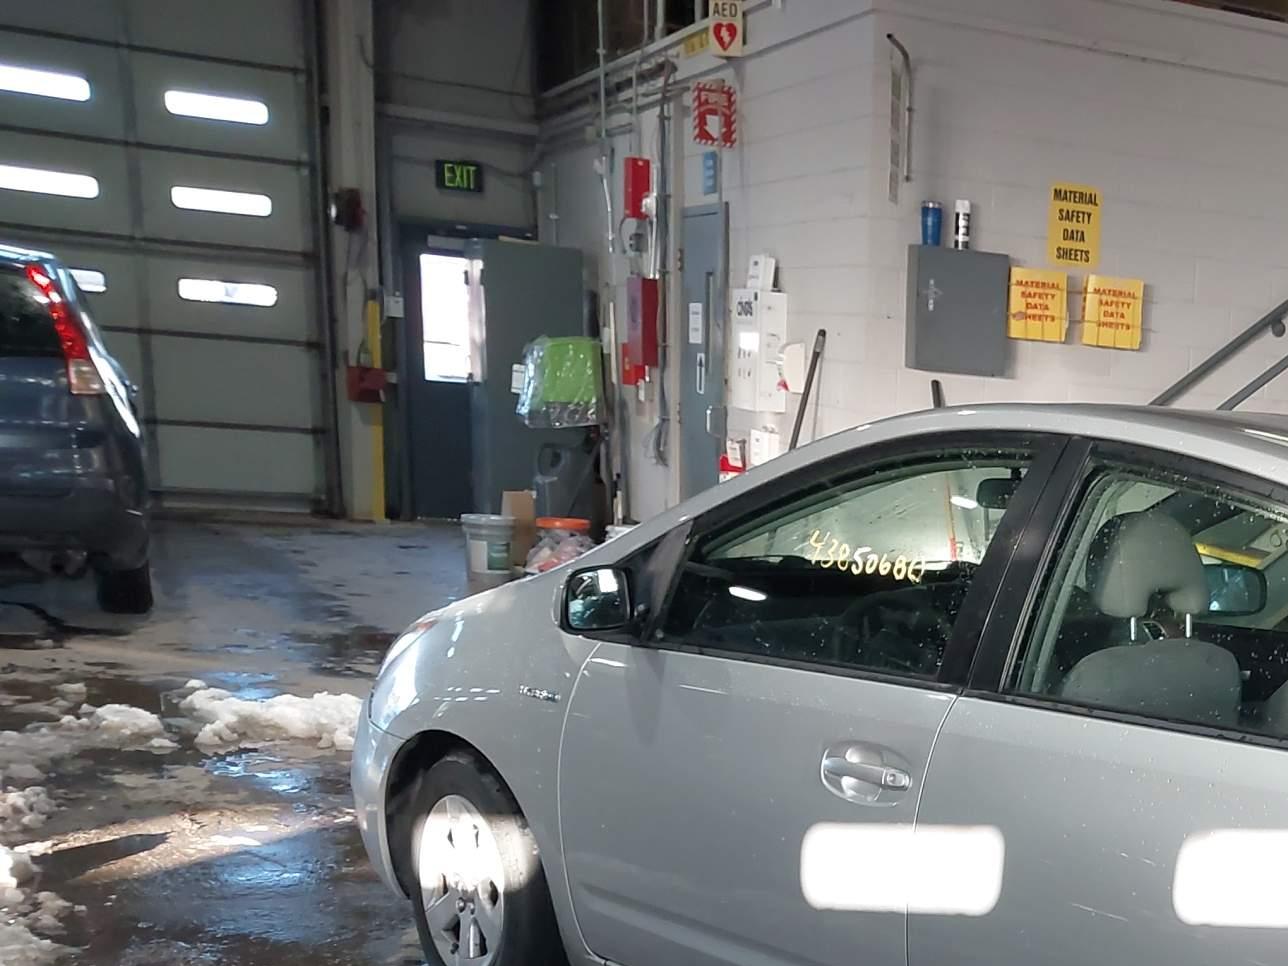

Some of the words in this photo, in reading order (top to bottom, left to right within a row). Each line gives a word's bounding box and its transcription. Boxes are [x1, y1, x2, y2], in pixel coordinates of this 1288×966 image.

[713, 2, 738, 18] AED
[444, 163, 477, 189] EXIT
[1054, 188, 1098, 207] MATERIAL
[1058, 208, 1092, 224] SAFETY
[1063, 229, 1085, 243] DATA
[1056, 246, 1090, 263] SHEETS
[1016, 279, 1060, 290] MATERIAL
[1021, 291, 1055, 301] SAFETY
[1094, 287, 1137, 300] MATERIAL
[1026, 302, 1049, 311] DATA
[1099, 299, 1131, 310] SAFETY
[1022, 313, 1056, 323] HEETS
[1103, 310, 1125, 320] DATA
